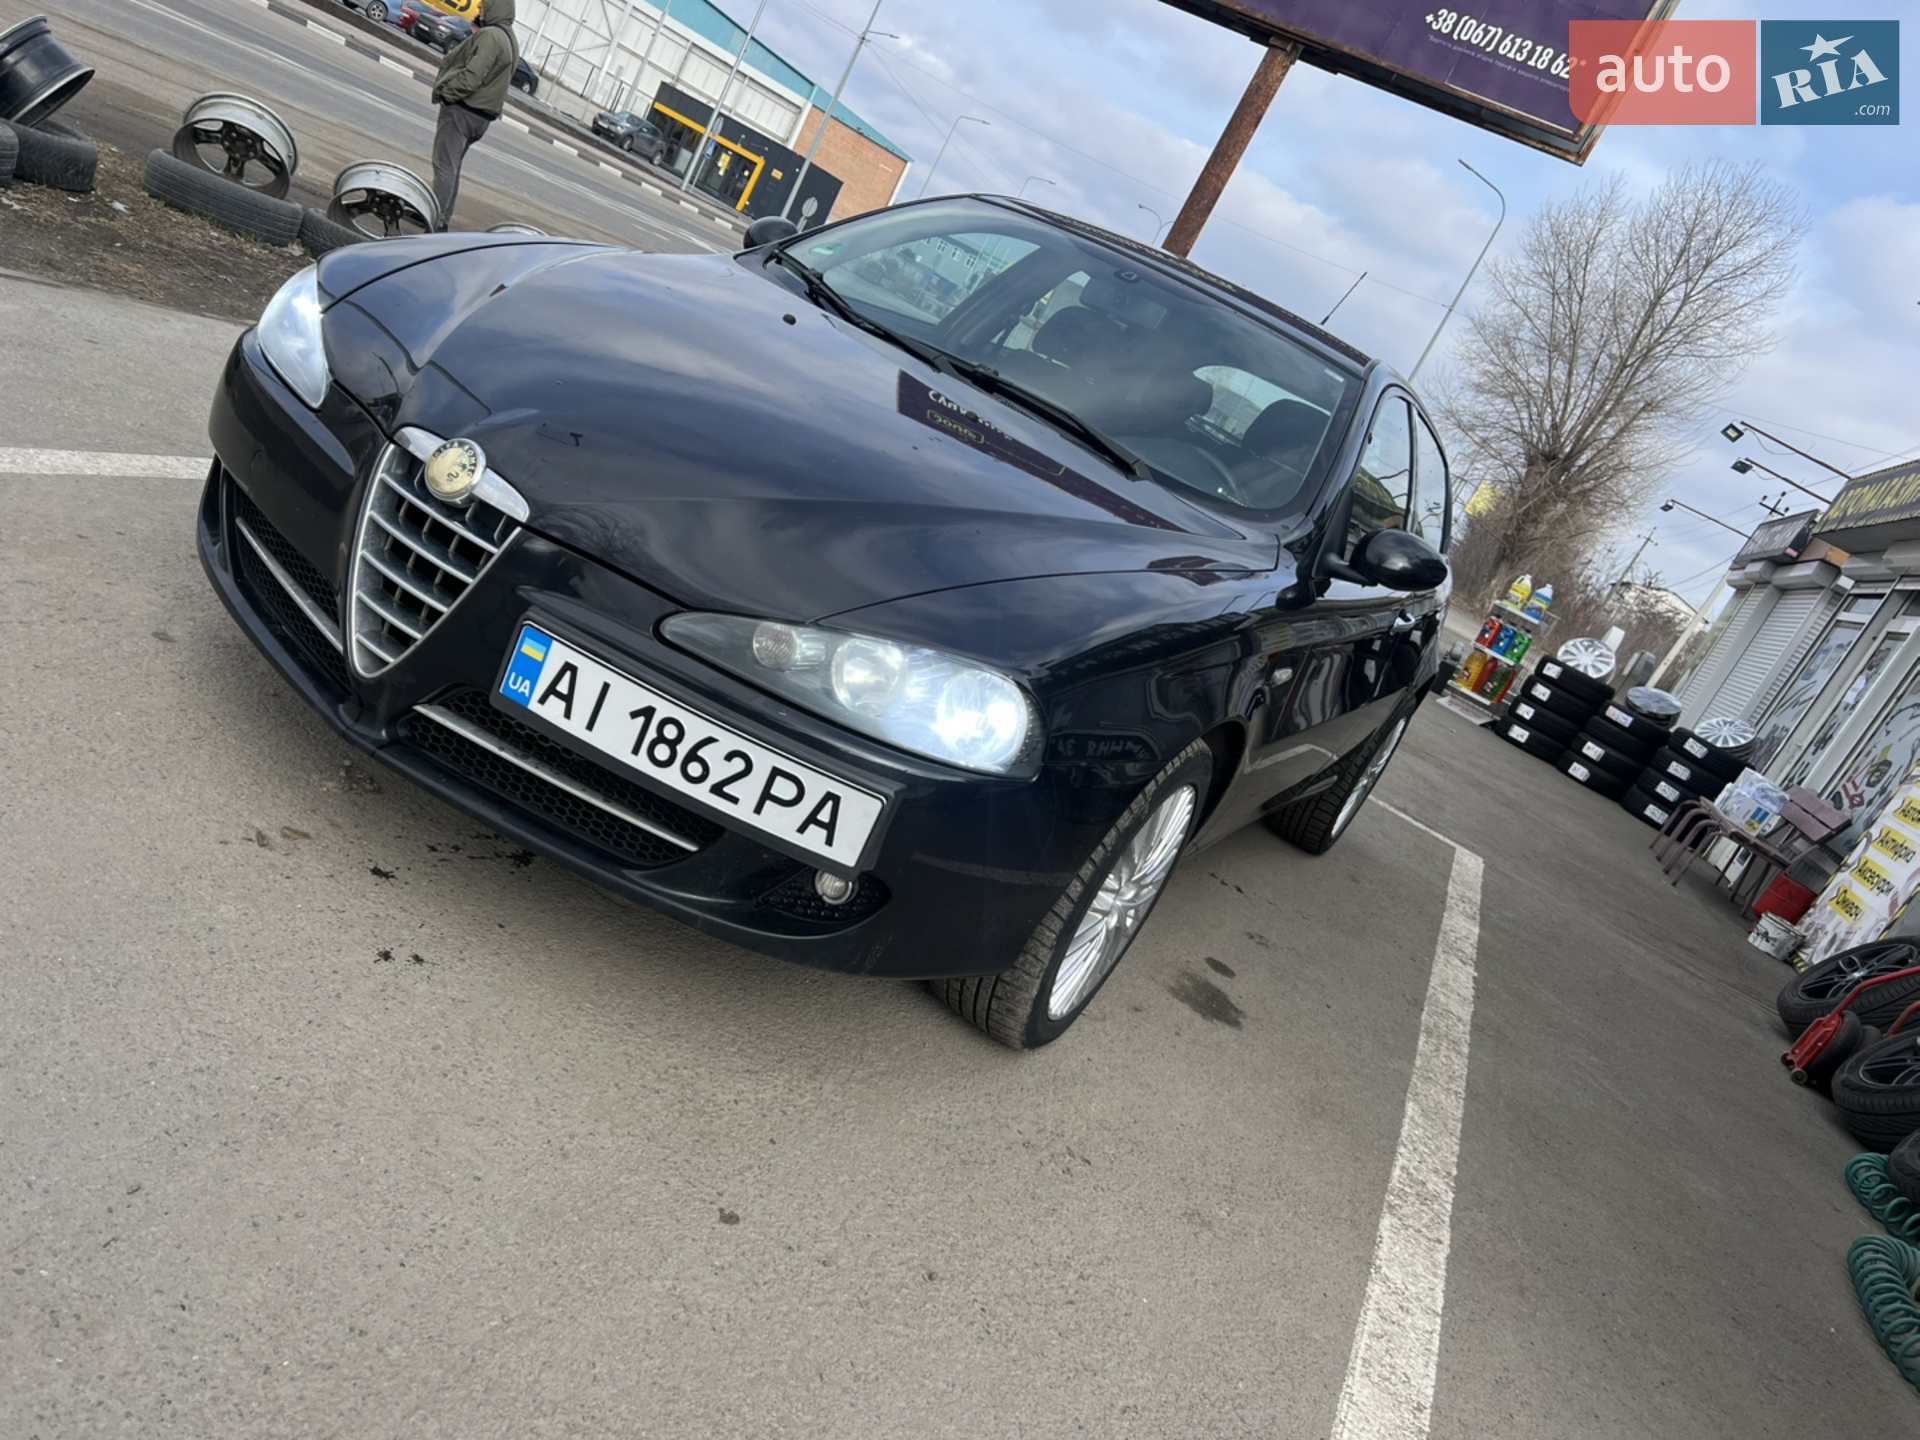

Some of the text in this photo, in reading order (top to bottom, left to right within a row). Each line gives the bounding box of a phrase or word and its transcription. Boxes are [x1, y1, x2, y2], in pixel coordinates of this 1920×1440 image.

[1425, 8, 1458, 34] +38
[1453, 15, 1503, 52] (067)
[1498, 33, 1533, 62] 613
[1527, 45, 1554, 70] 18
[507, 674, 531, 698] UA
[536, 660, 843, 848] AI 1862 PA
[1876, 830, 1917, 863] Антифриз
[1854, 860, 1896, 897] Аксесуари
